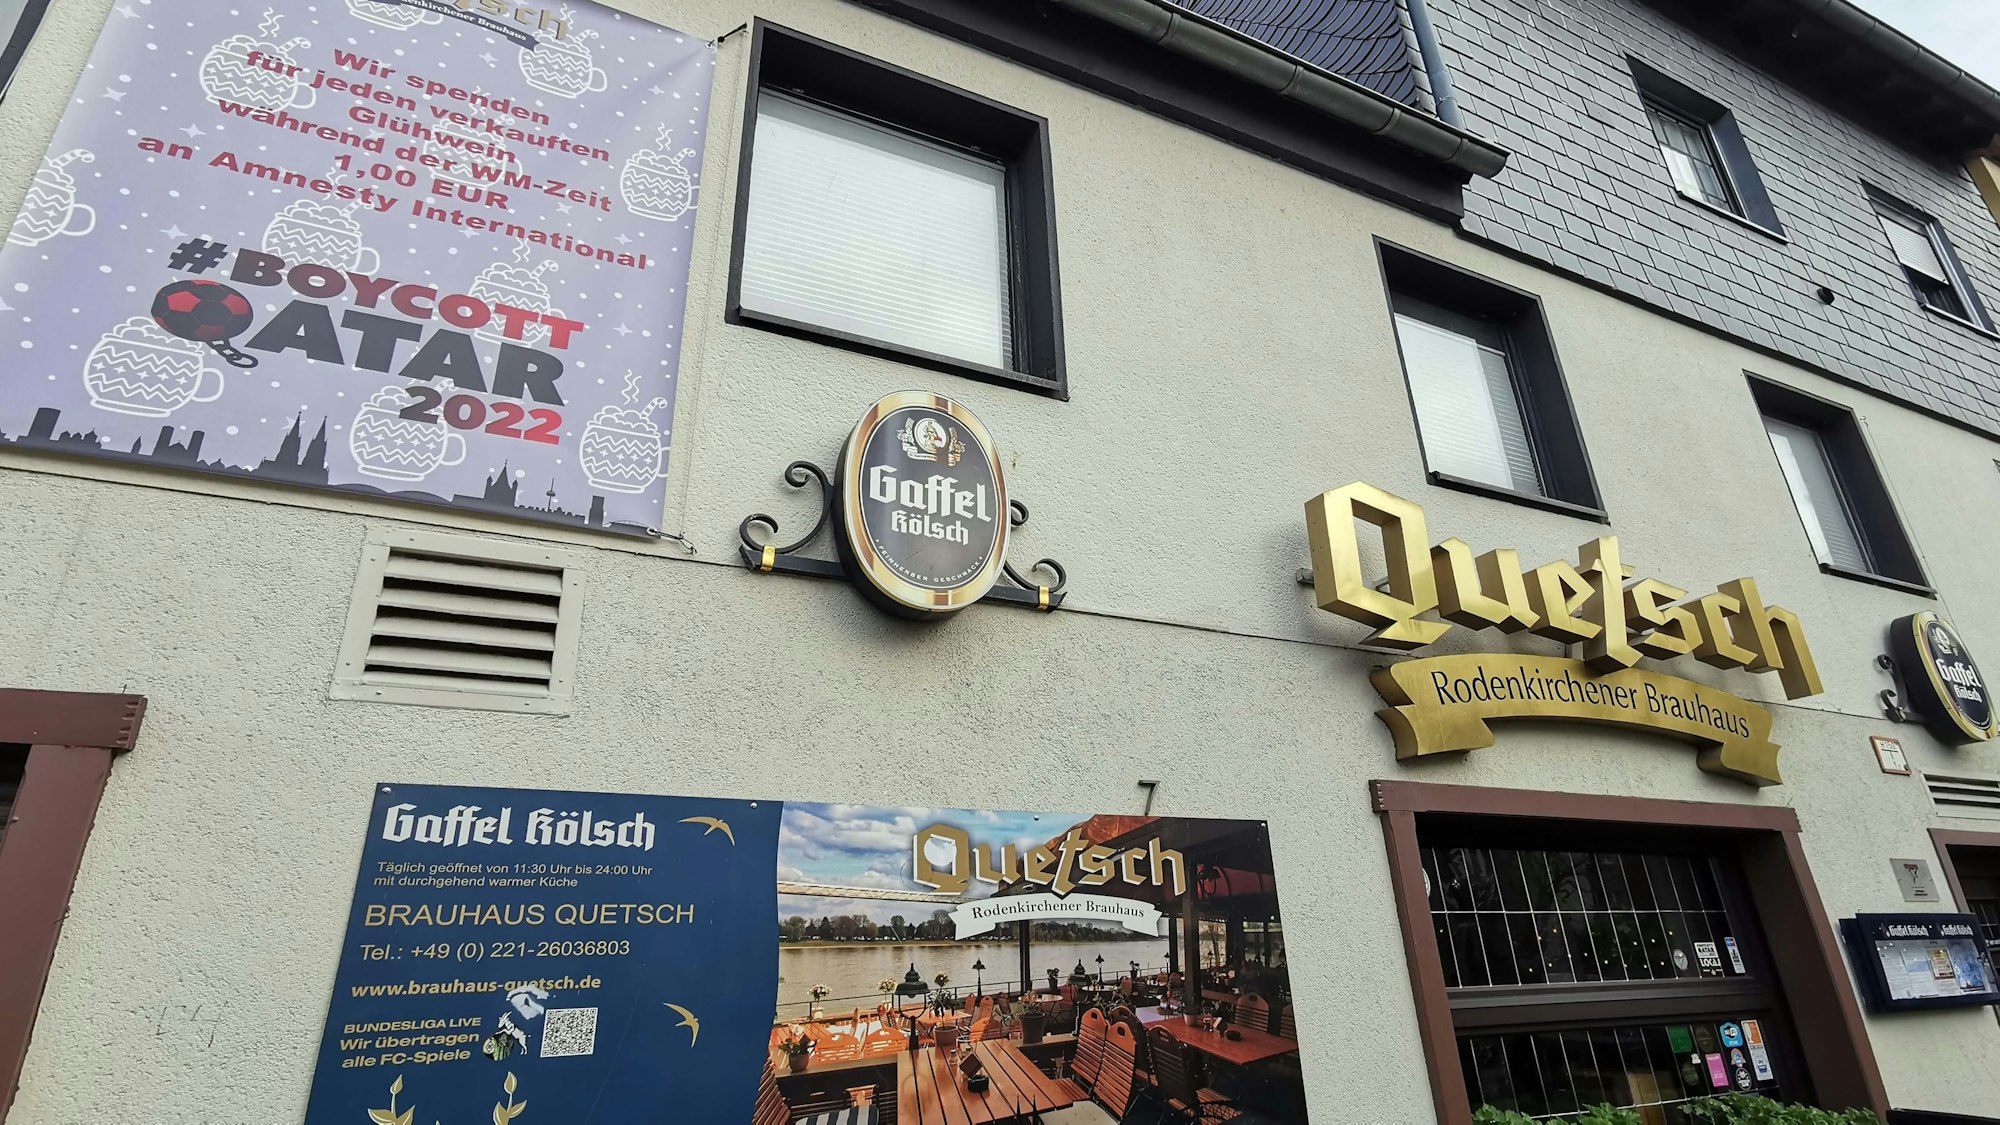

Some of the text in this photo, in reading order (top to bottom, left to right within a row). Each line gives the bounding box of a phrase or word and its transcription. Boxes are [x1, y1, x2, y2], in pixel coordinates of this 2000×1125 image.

[477, 18, 527, 41] Brauhaus
[247, 50, 609, 161] für jeden verkauften
[334, 49, 550, 126] Wir spenden
[218, 99, 611, 212] während der WM-Zeit
[349, 106, 516, 163] Glühwein
[137, 137, 647, 270] an Amnesty International
[334, 154, 509, 210] 1,00 EUR
[167, 238, 584, 349] #BOYCOTT
[398, 386, 562, 445] 2022
[869, 464, 991, 522] Gaffel
[891, 509, 969, 546] Kölsch
[878, 545, 980, 582] FEINHERBER GESCHMACK
[1304, 480, 1824, 700] Quetsch
[1936, 658, 1982, 687] Gaffel
[1431, 665, 1750, 739] Rodenkirchener Brauhaus
[382, 802, 655, 851] Gaffel Kölsch
[374, 876, 578, 889] mit durchgehend warmer Küche
[377, 861, 652, 876] Täglich geöffnet von 11:30 Uhr bis 24:00 Uhr
[912, 823, 1187, 897] Quetsch
[364, 903, 694, 926] BRAUHAUS QUETSCH
[972, 899, 1145, 920] Rodenkirchener Brauhaus
[360, 940, 631, 962] Tel.: +49 (0) 221-26036803
[339, 1033, 480, 1051] Wir übertragen
[343, 1017, 482, 1034] BUNDESLIGA LIVE
[342, 1049, 471, 1068] alle FC-Spiele
